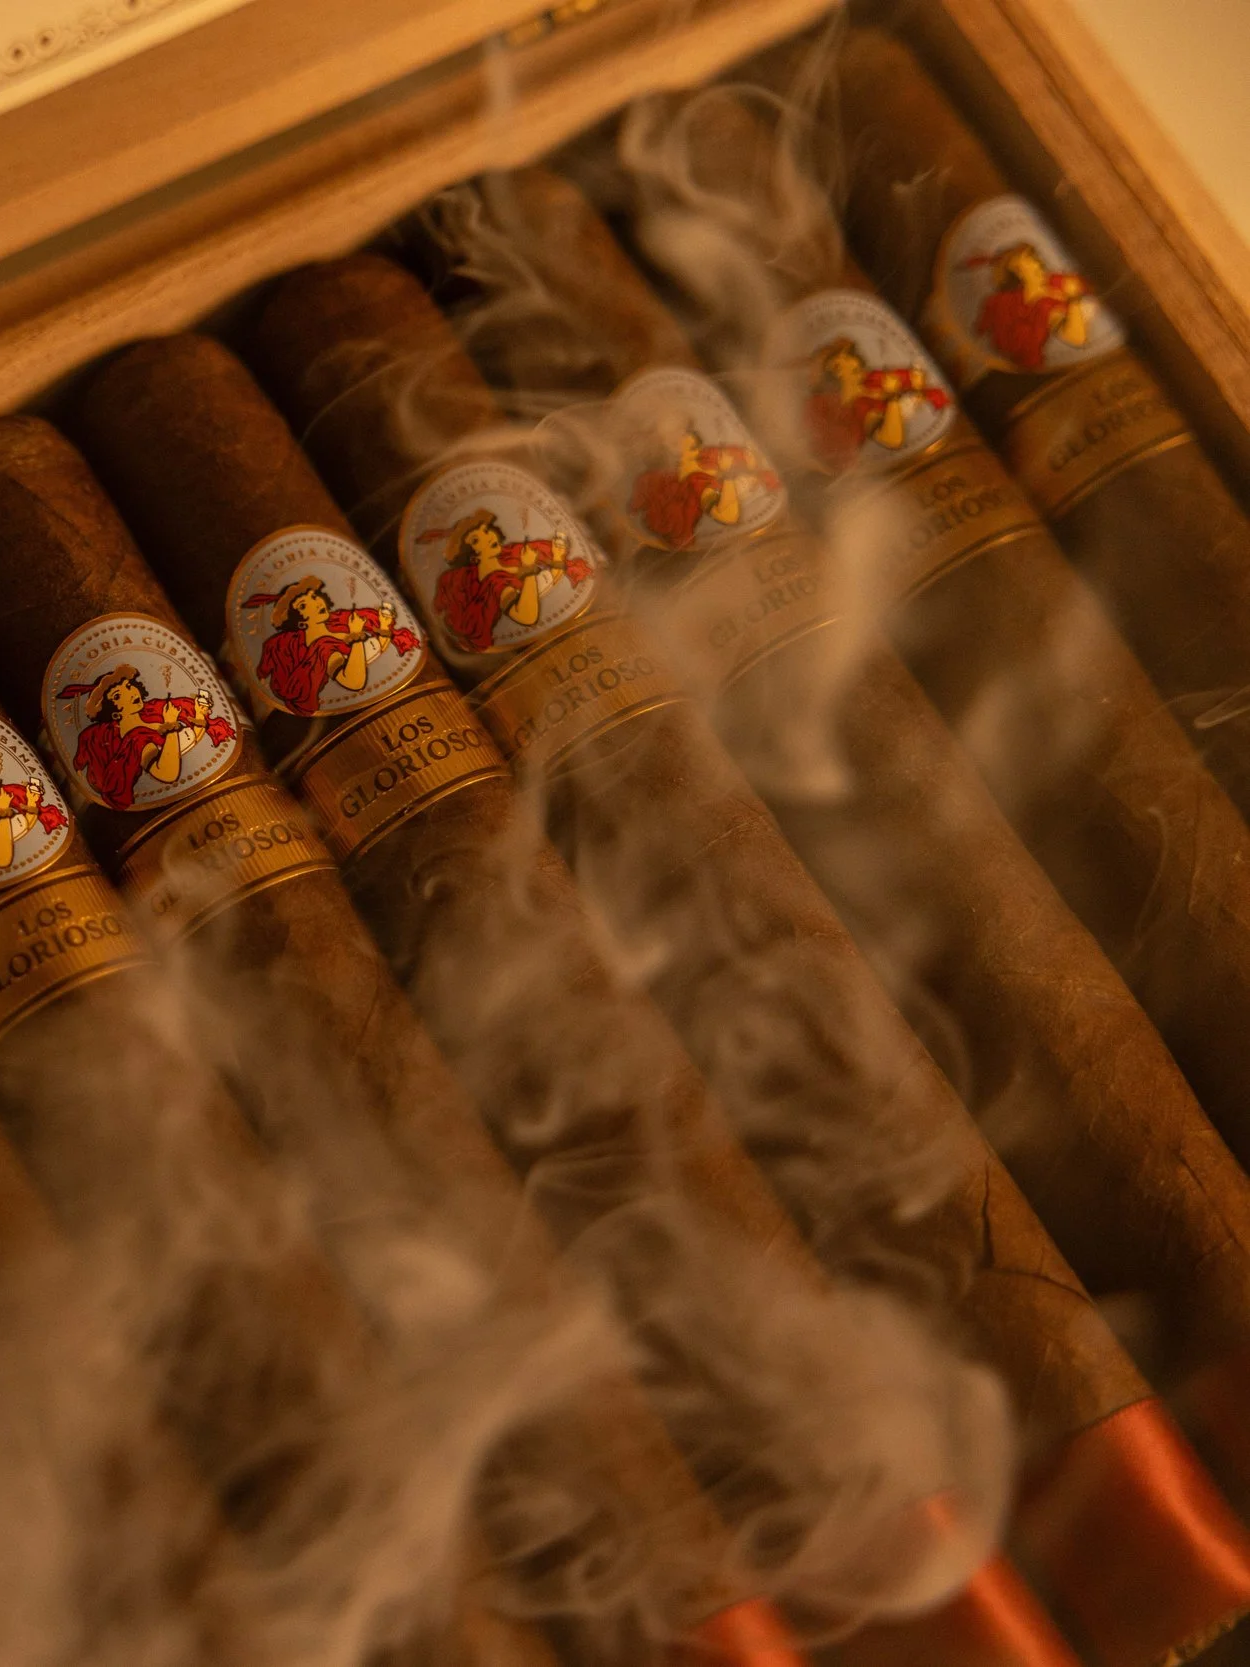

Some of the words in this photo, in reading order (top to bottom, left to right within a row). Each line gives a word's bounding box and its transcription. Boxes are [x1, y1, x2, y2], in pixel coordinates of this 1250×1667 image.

[257, 547, 318, 590] GLORIA
[327, 547, 389, 598] CUBANA
[752, 556, 800, 586] LOS
[69, 635, 134, 681] GLORIA
[141, 635, 206, 687] CUBANA
[550, 645, 604, 685] LOS
[513, 655, 658, 749] GLORIOSO
[381, 715, 435, 753] LOS
[186, 812, 241, 851] LOS
[17, 900, 73, 937] LOS
